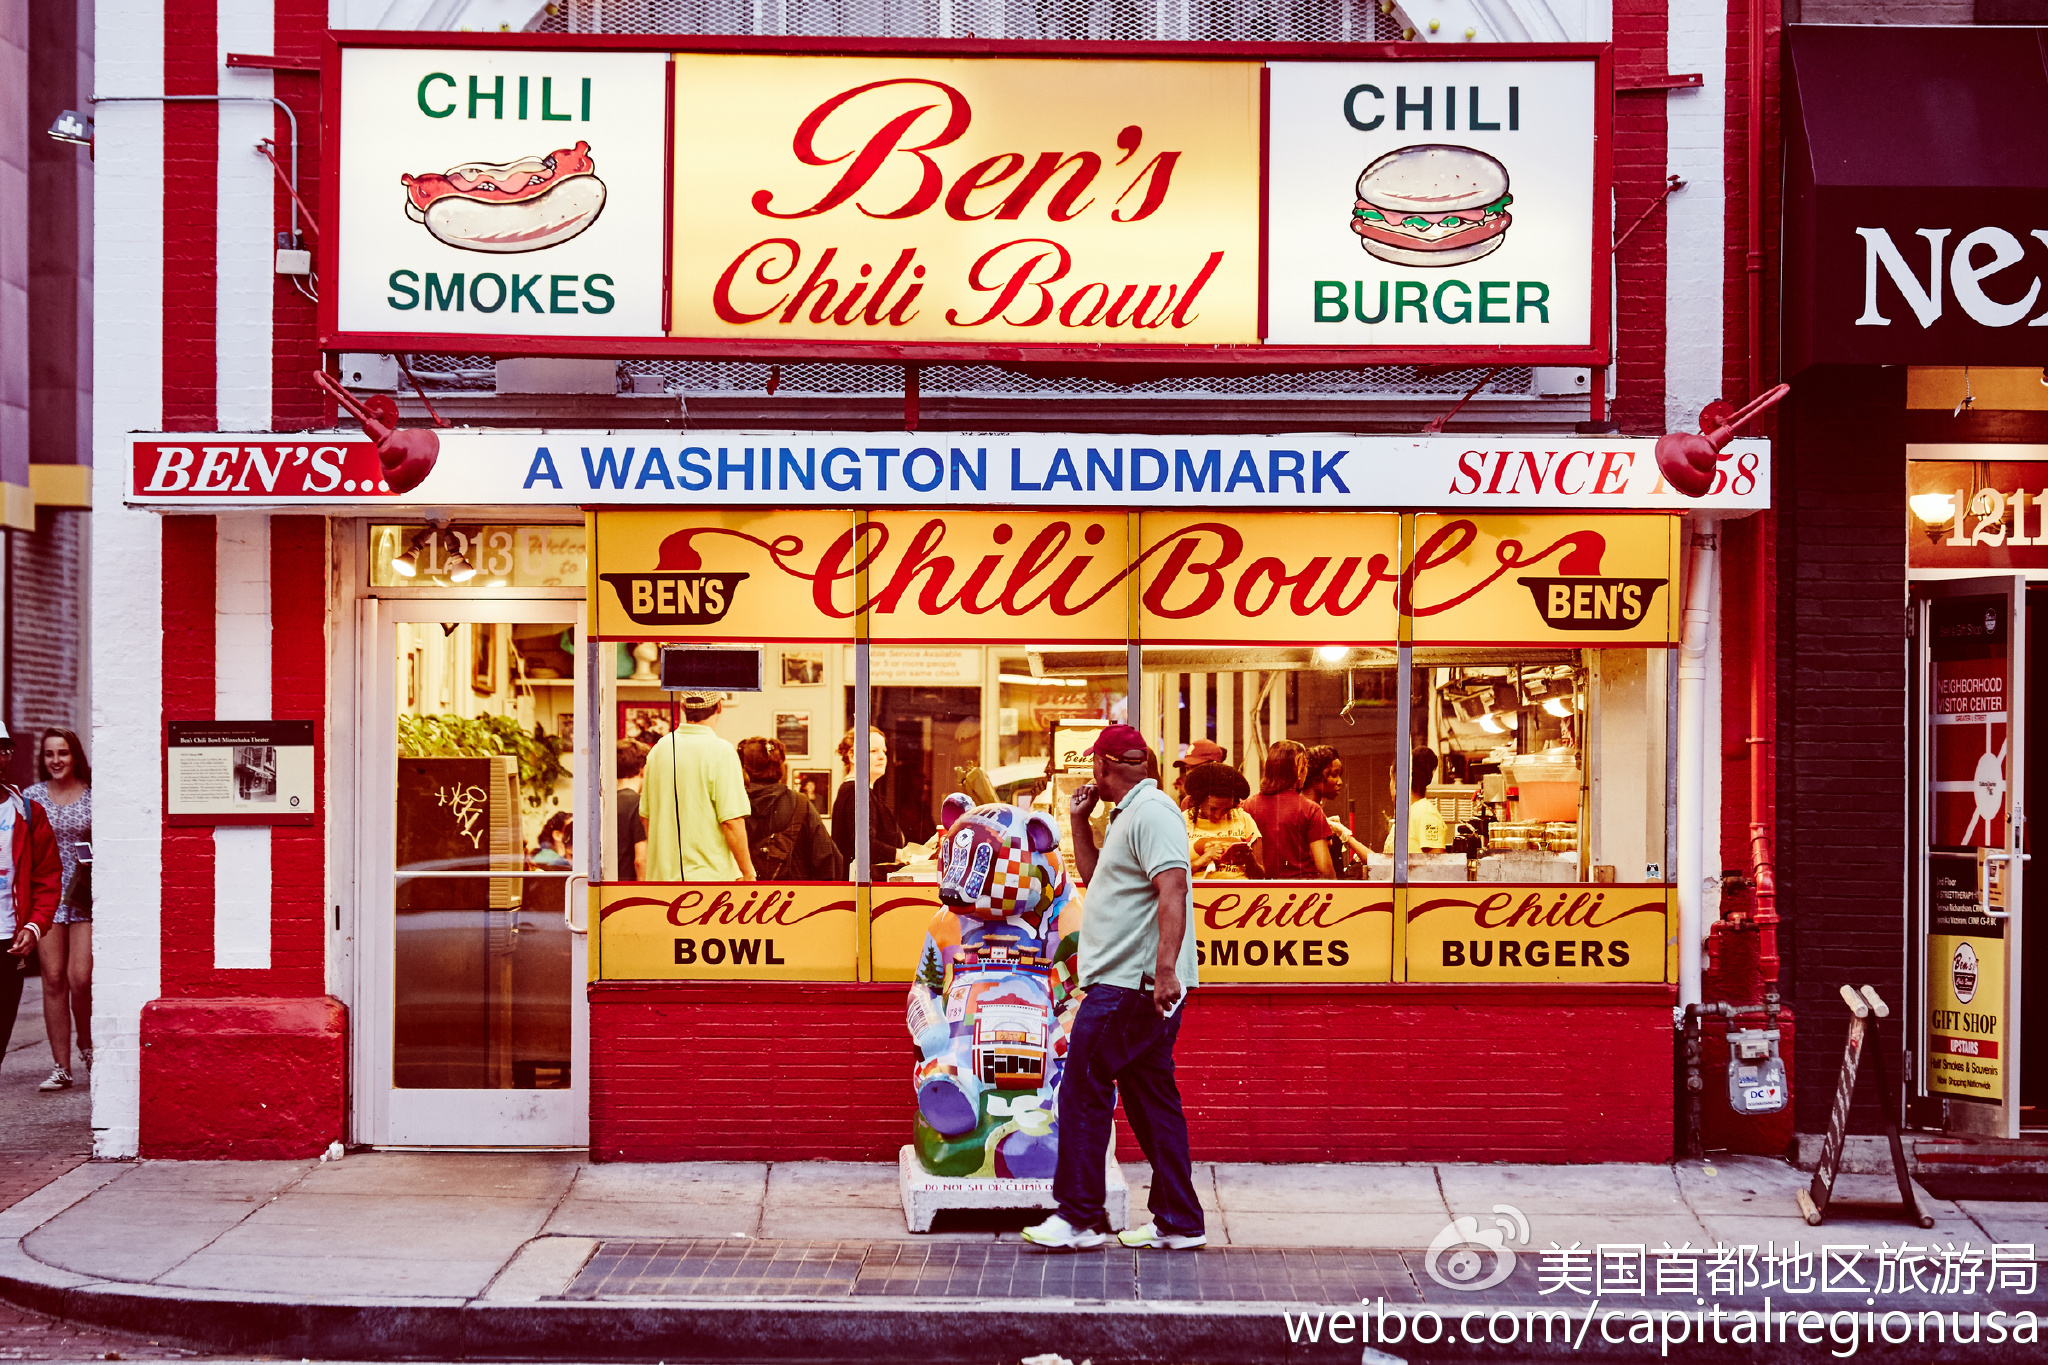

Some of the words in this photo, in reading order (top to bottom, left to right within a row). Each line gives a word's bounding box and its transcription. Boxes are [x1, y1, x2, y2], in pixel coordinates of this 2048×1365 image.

[418, 72, 592, 122] CHILI
[1343, 84, 1519, 131] CHILI
[751, 78, 1182, 223] Ben's
[386, 269, 616, 315] SMOKES
[712, 238, 926, 326] Chili
[945, 238, 1225, 329] Bowl
[1314, 280, 1550, 324] BURGER
[522, 446, 563, 490] A
[581, 446, 987, 492] WASHINGTON
[1011, 447, 1350, 494] LANDMARK
[1448, 450, 1636, 496] SINCE
[1648, 452, 1758, 496] 158
[1946, 487, 2048, 548] 1211
[517, 528, 552, 576] U
[805, 518, 1118, 619] Chili
[1140, 519, 1480, 619] Bowl
[632, 579, 726, 615] BEN'S
[1547, 581, 1642, 621] BEN'S
[870, 670, 893, 678] aying
[926, 660, 956, 668] people
[1937, 677, 2002, 693] NEIGHBORHOOD
[1937, 697, 1968, 712] VISITOR
[1970, 696, 2002, 711] CENTER
[666, 889, 797, 926] Chili
[1204, 892, 1337, 929] Chili
[1474, 892, 1607, 928] Chili
[674, 938, 785, 965] BOWL
[1195, 939, 1350, 967] SMOKES
[1442, 939, 1630, 967] BURGERS
[1932, 1009, 1960, 1030] GIFT
[1963, 1013, 1997, 1034] SHOP
[1950, 1039, 1978, 1055] UPSTAIRS
[1942, 1059, 1965, 1072] Smokes
[1965, 1062, 1970, 1073] &
[1971, 1062, 1998, 1076] Souvenirs
[1948, 1076, 1967, 1088] Shipping
[1750, 1089, 1765, 1099] DC
[968, 1184, 983, 1192] SIT
